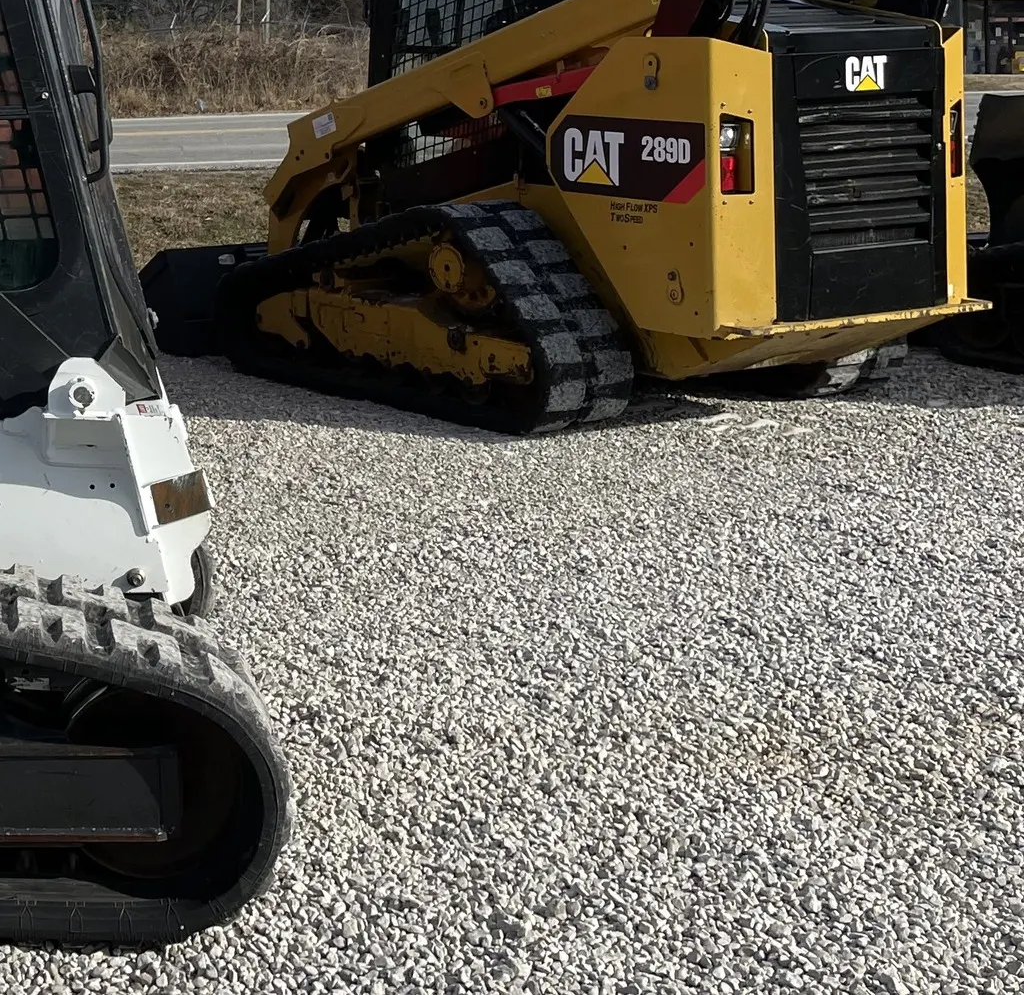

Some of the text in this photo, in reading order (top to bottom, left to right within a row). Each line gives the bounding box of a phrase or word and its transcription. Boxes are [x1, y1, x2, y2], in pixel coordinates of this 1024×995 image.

[845, 55, 888, 92] CAT
[563, 127, 691, 187] CAT 289D
